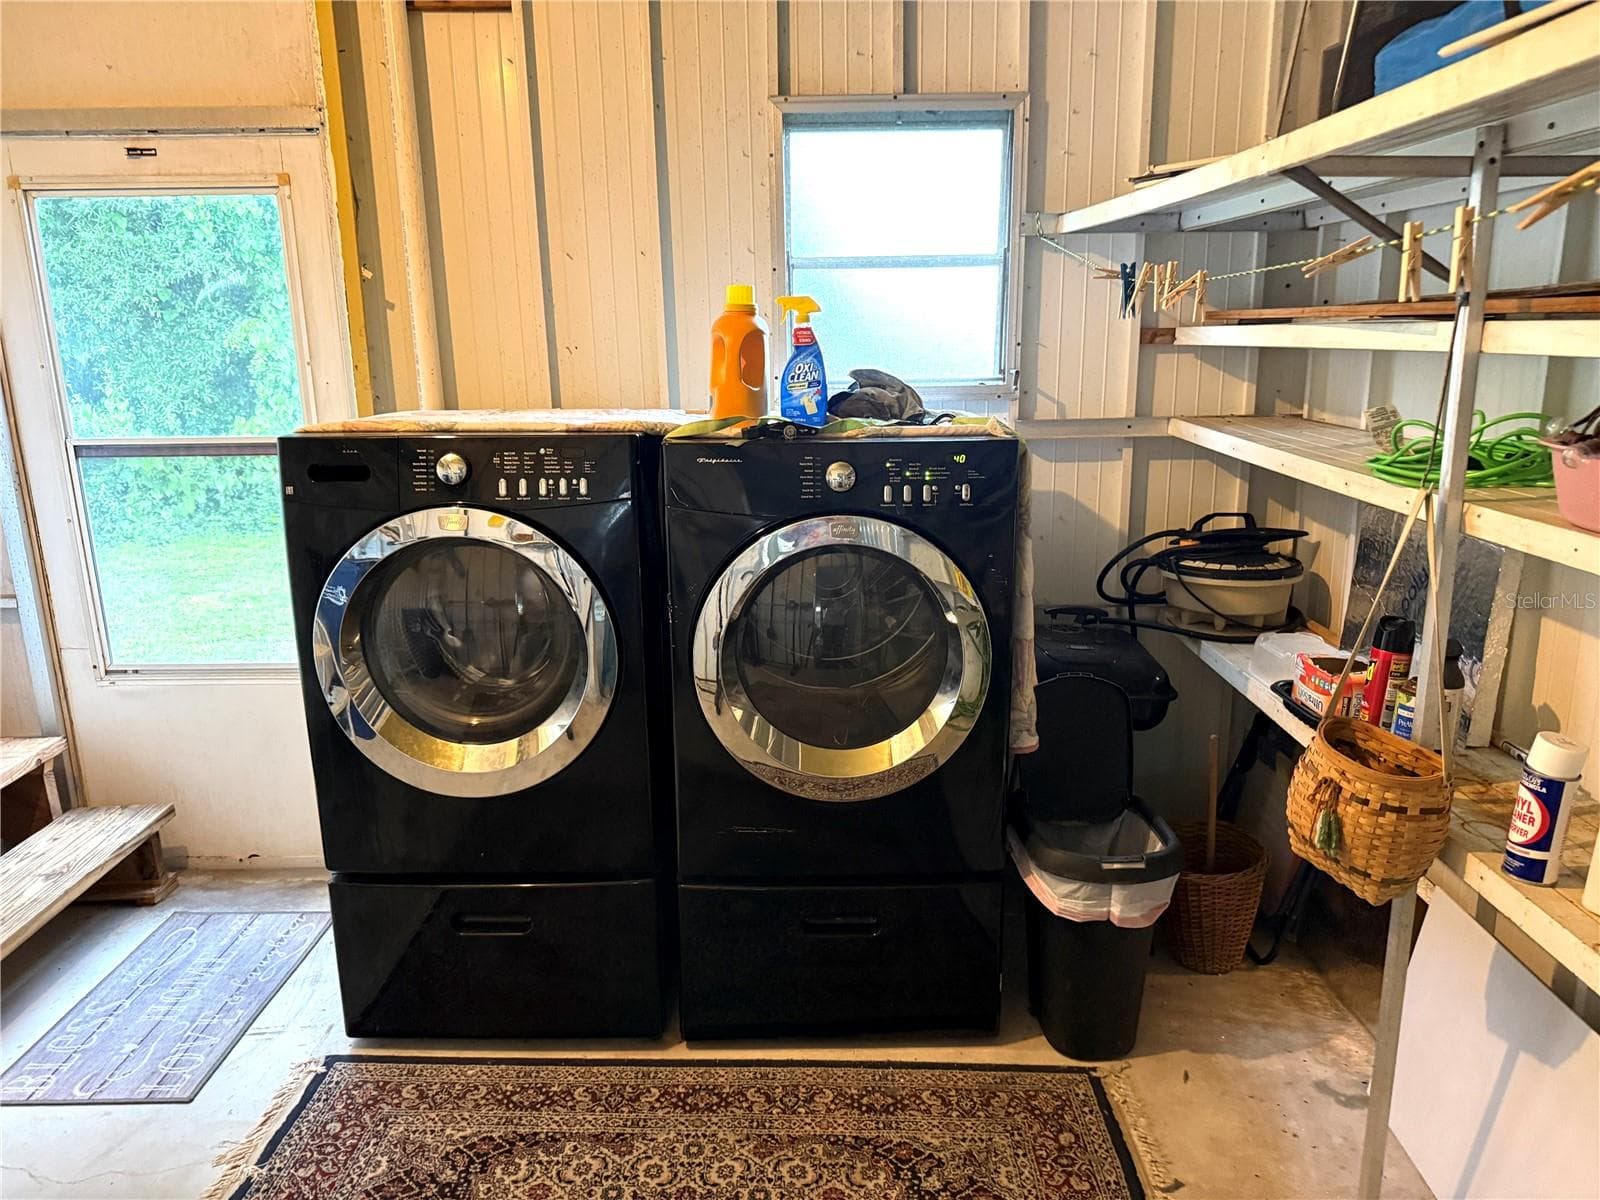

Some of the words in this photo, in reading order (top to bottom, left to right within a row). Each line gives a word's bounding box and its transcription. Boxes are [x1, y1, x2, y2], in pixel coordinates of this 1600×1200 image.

[795, 362, 815, 374] OXI
[788, 370, 819, 383] CLEAN
[953, 454, 966, 464] 40
[832, 524, 856, 535] affinity
[134, 1009, 245, 1096] LOVE
